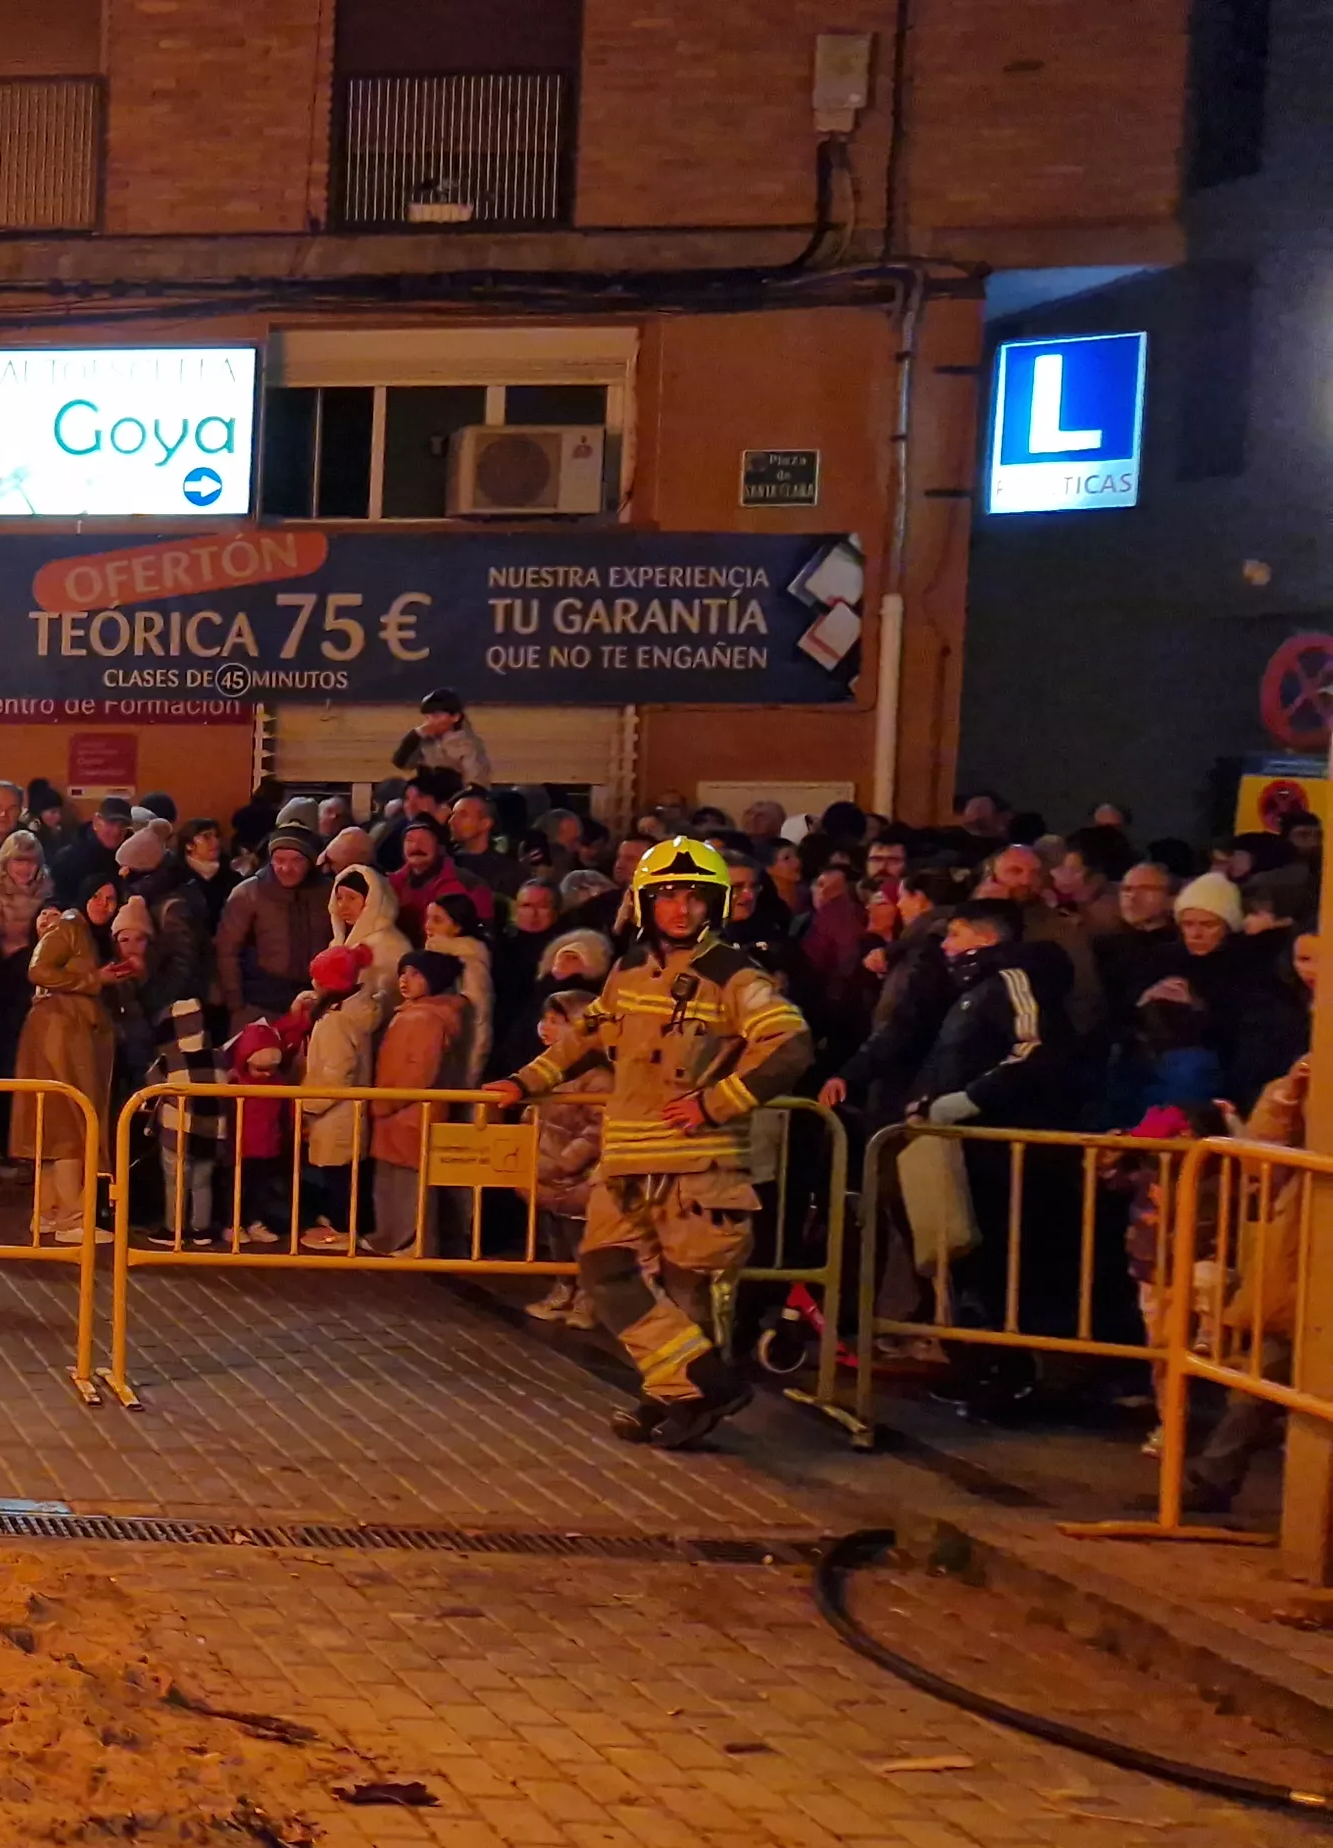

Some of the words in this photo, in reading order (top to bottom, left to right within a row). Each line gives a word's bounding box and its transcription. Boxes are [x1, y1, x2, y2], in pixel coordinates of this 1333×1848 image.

[1028, 353, 1103, 454] L
[53, 399, 236, 467] Goya
[64, 532, 299, 602] OFERTÓN
[488, 567, 601, 588] NUESTRA
[609, 566, 770, 589] EXPERIENCIA
[29, 600, 259, 657] TEÓRICA
[276, 593, 366, 660] 75
[488, 598, 540, 635] TU
[553, 590, 769, 635] GARANTÍA
[103, 669, 179, 688] CLASES
[186, 670, 214, 688] DE
[221, 671, 244, 689] 45
[252, 670, 348, 689] MINUTOS
[486, 645, 541, 675] QUE
[550, 646, 591, 668] NO
[600, 646, 628, 668] TE
[637, 641, 768, 669] ENGAÑEN
